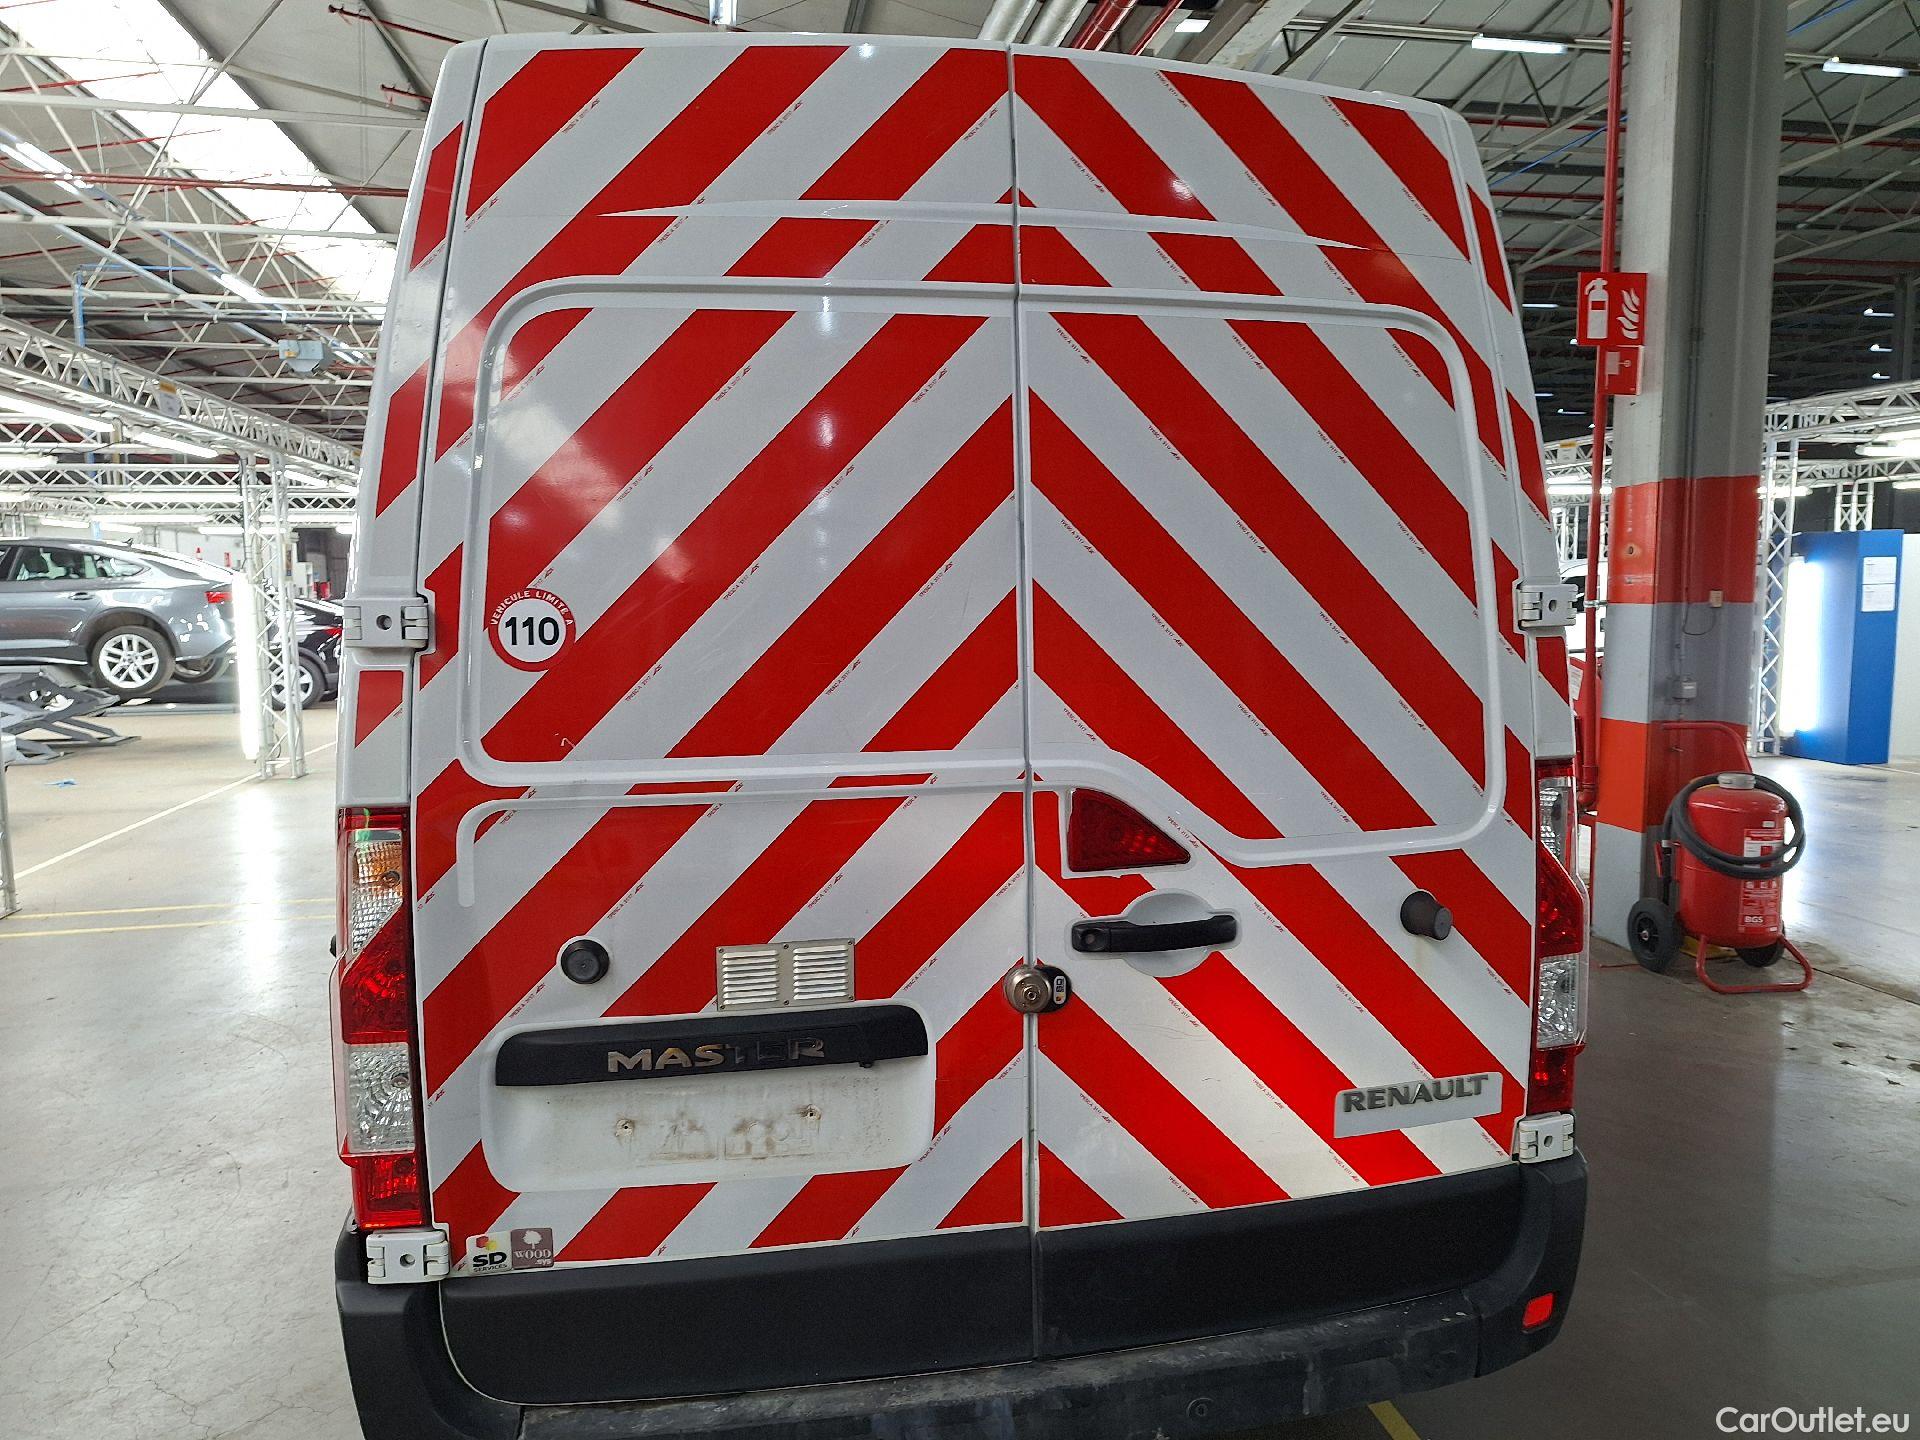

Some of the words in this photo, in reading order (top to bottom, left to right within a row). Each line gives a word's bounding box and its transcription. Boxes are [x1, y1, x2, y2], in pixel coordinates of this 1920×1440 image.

[505, 616, 559, 646] 110
[1343, 1074, 1489, 1112] RENAULT
[472, 1251, 507, 1268] SD
[473, 1263, 507, 1272] SERVICES
